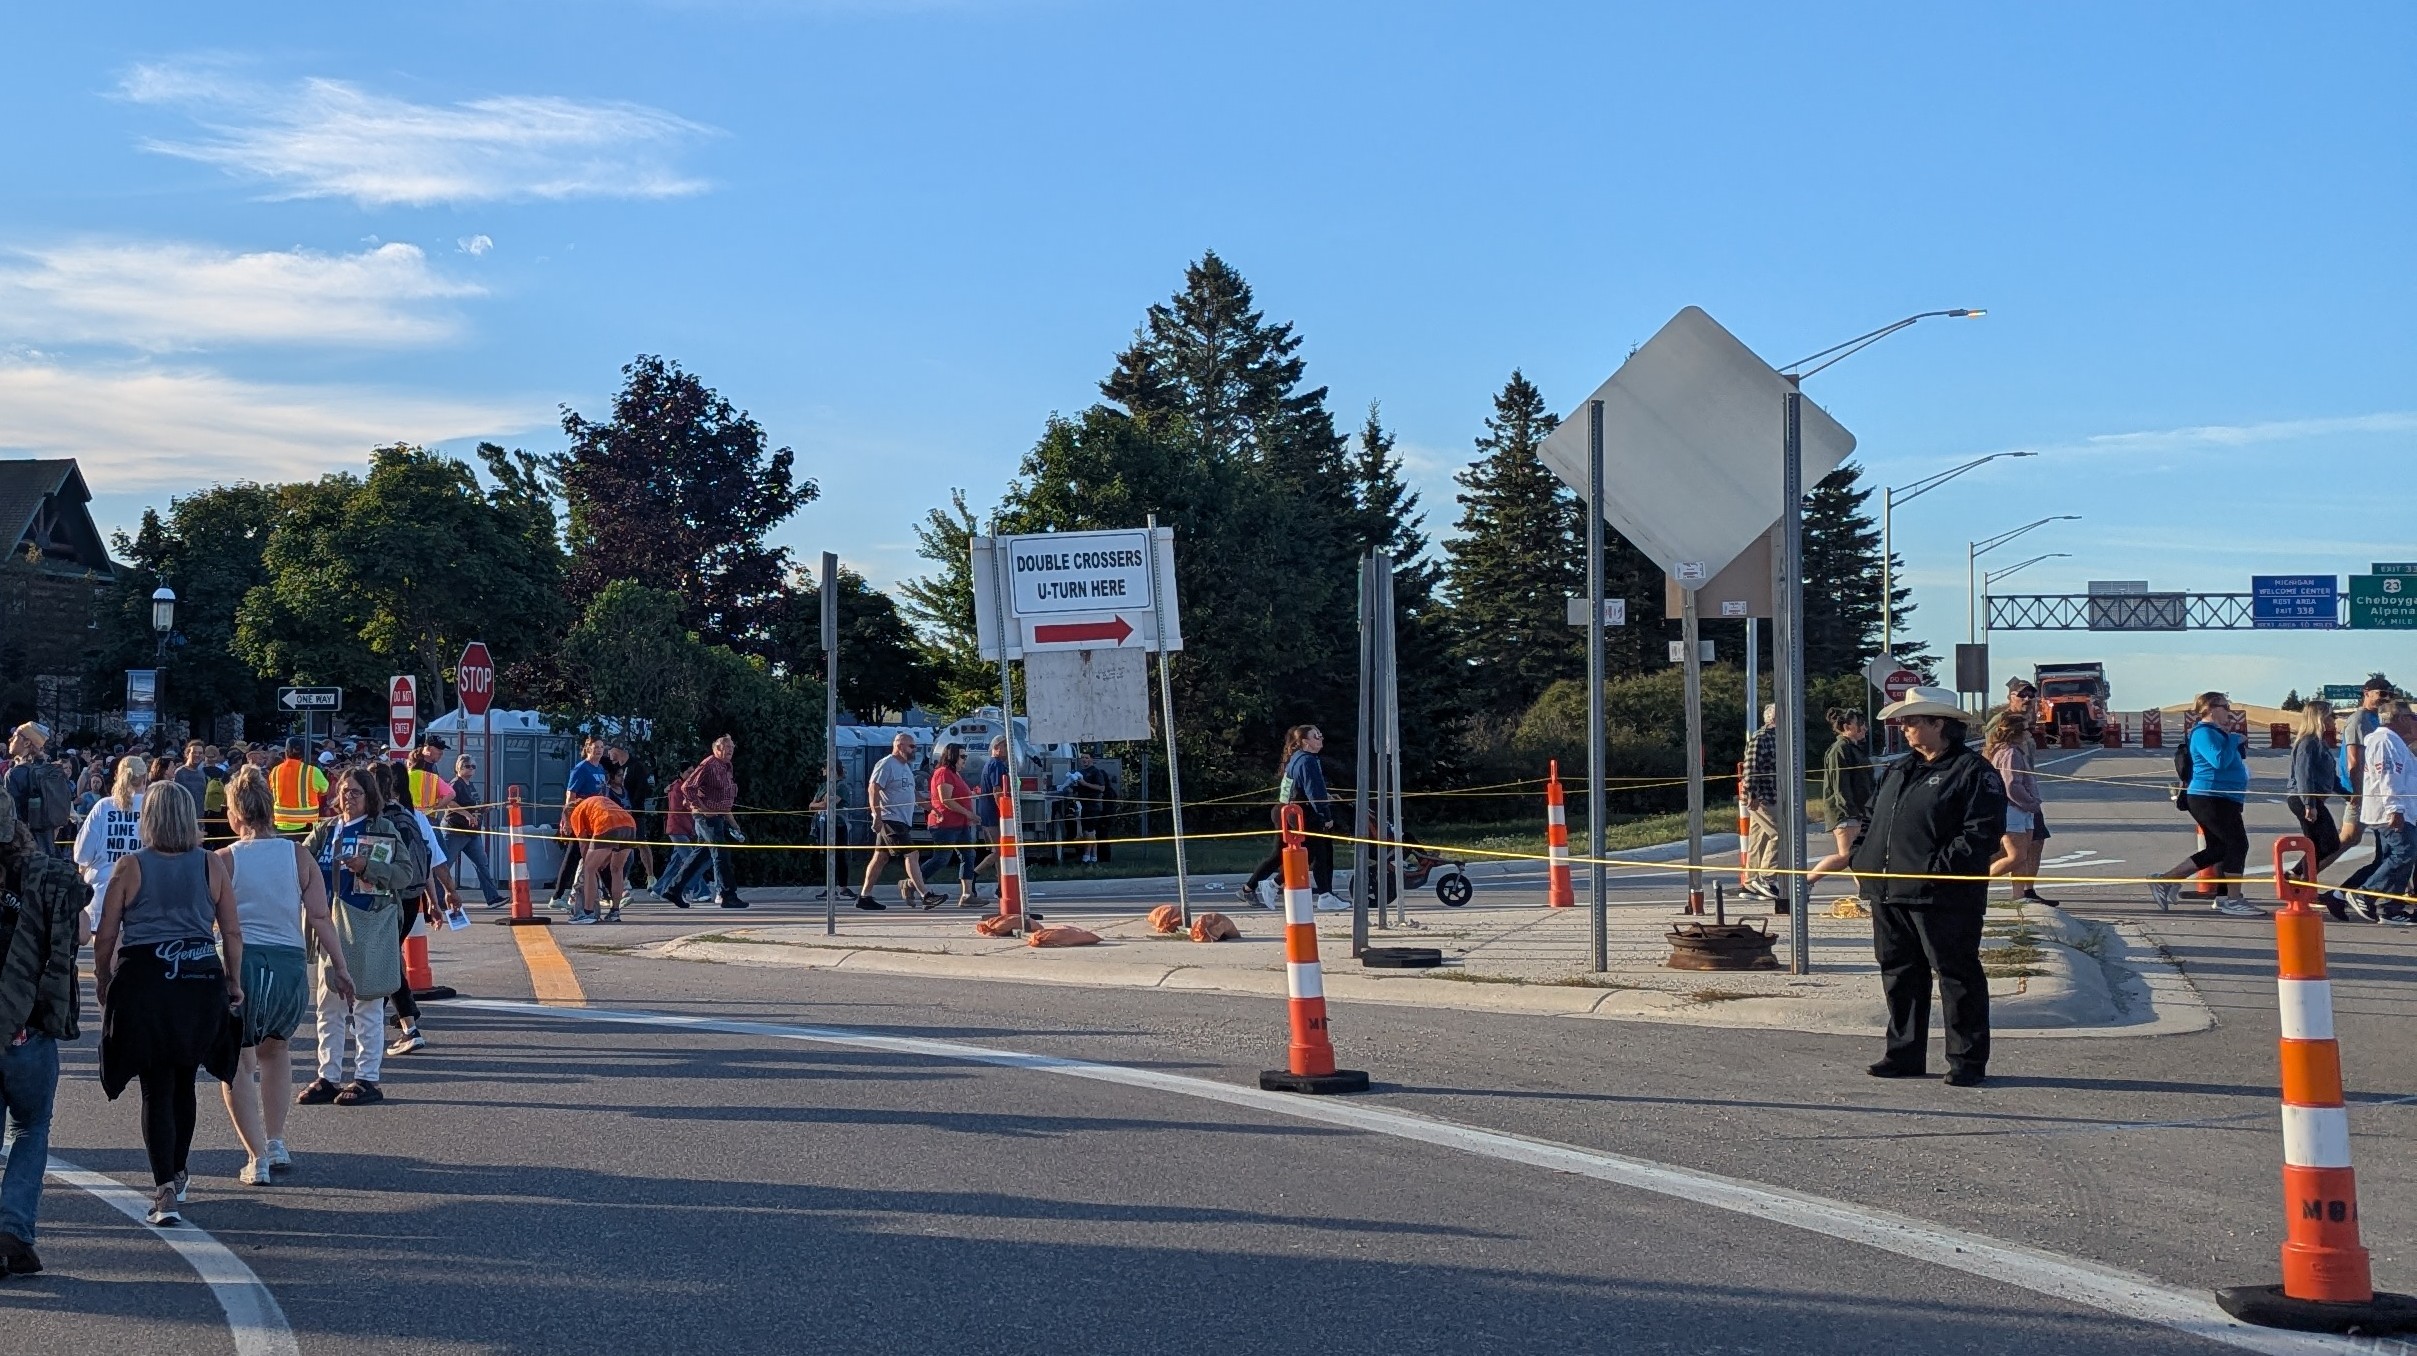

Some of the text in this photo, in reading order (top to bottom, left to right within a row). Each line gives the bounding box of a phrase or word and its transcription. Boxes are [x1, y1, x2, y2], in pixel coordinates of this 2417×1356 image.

[1016, 550, 1143, 572] DOUBLE CROSSERS
[1037, 578, 1126, 599] U-TURN HERE
[2300, 587, 2331, 595] CENTER
[2385, 581, 2400, 590] 23
[2275, 606, 2315, 615] EXIT 338
[2370, 606, 2416, 617] Alpena
[460, 665, 492, 694] STOP
[296, 695, 333, 704] ONE WAY
[393, 690, 412, 702] DO NOT
[107, 823, 135, 837] LINE
[106, 837, 125, 850] NO
